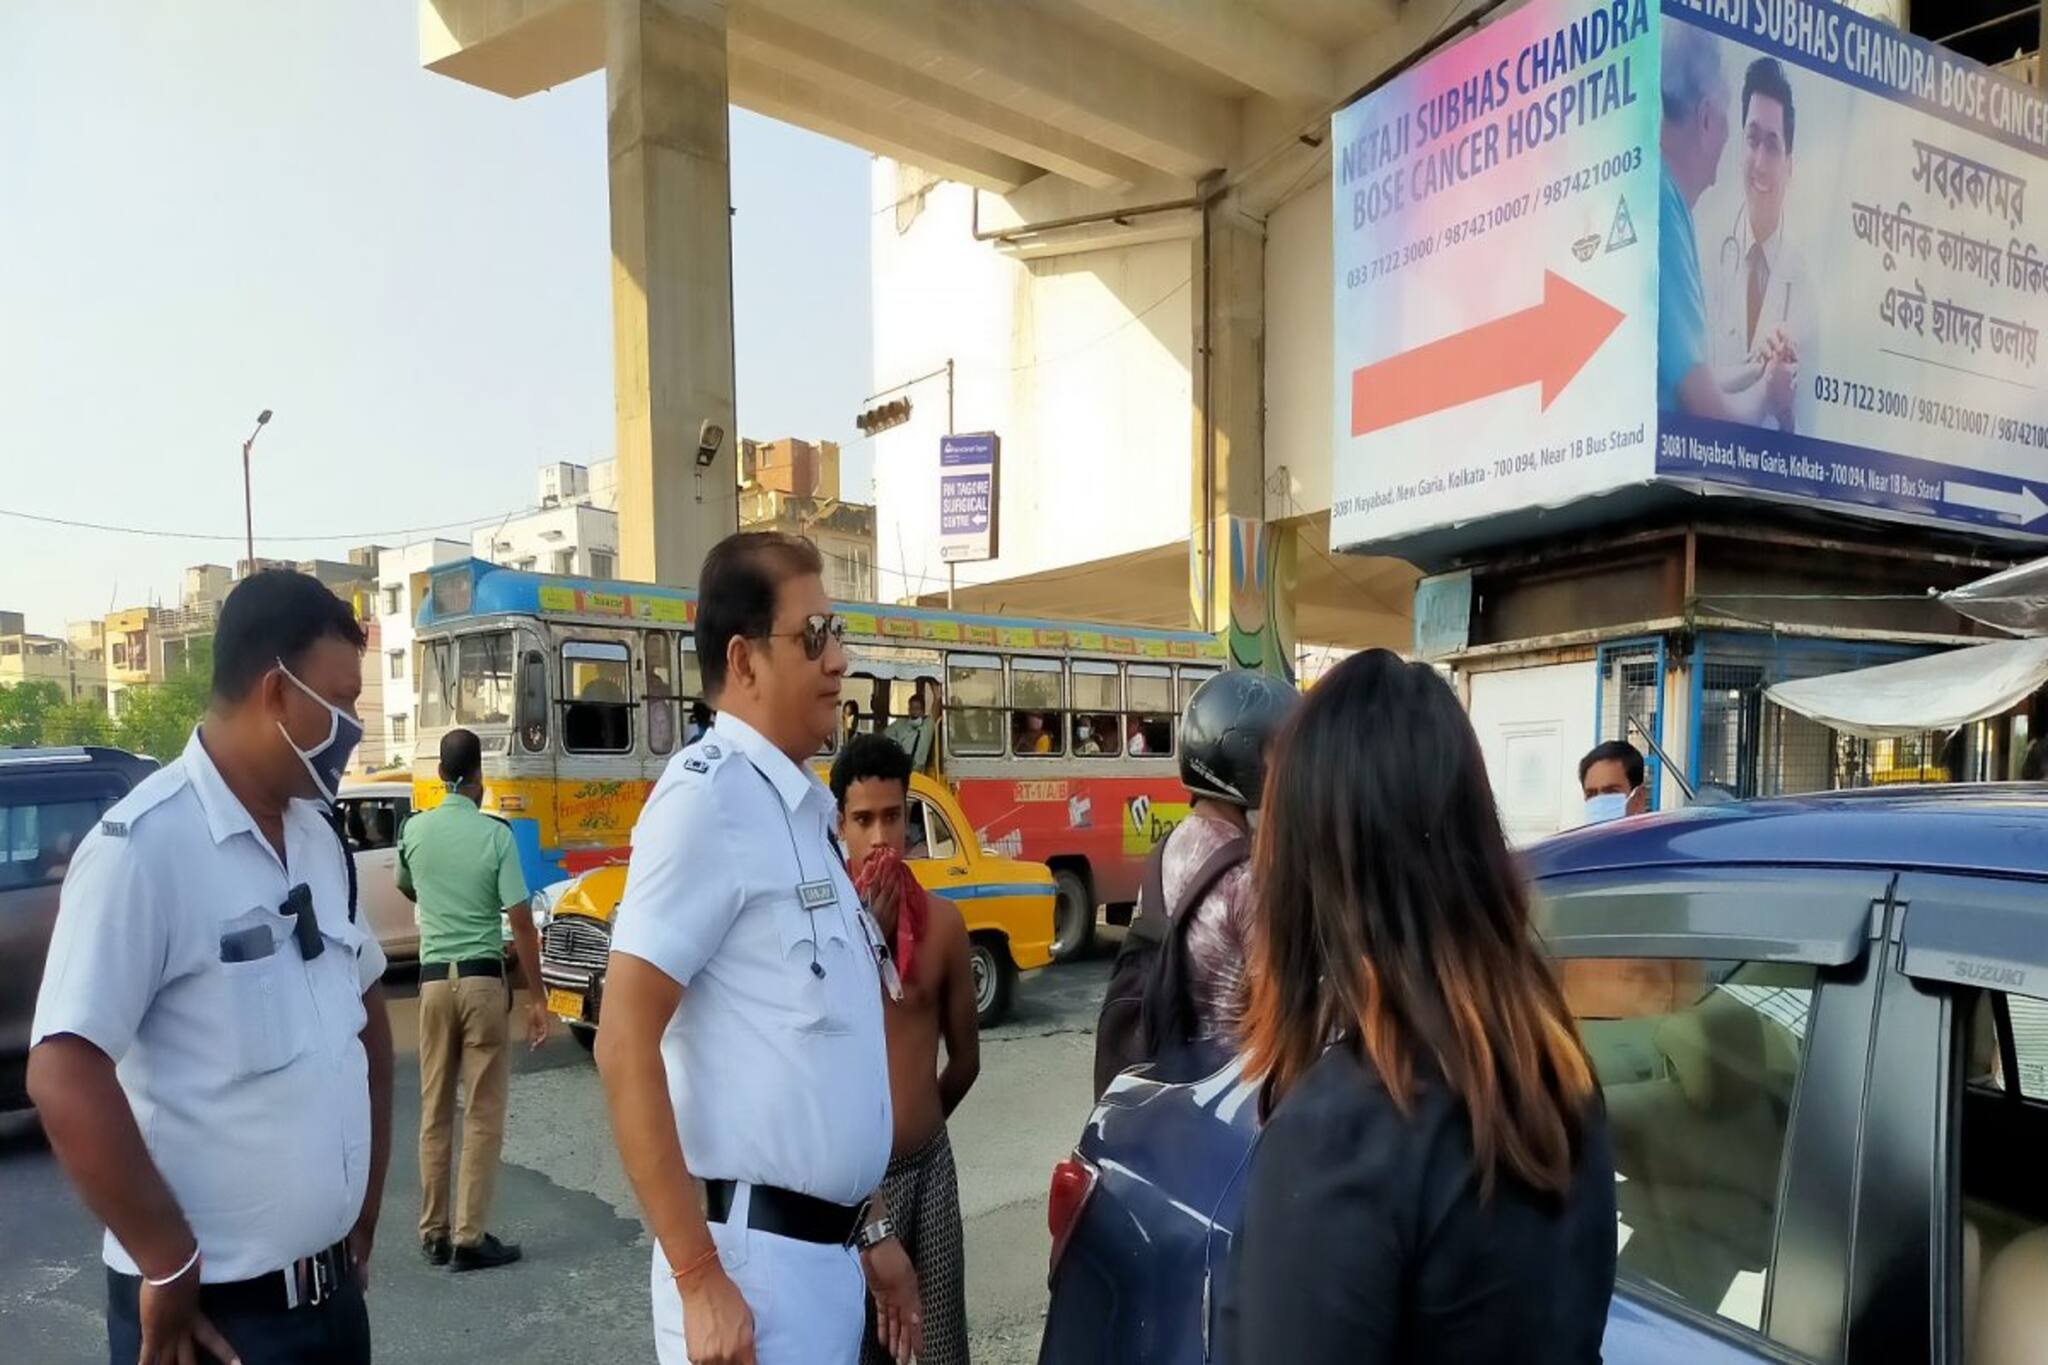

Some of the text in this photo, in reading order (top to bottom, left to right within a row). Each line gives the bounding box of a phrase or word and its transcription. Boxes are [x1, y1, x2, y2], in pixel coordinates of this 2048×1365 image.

[1341, 0, 1649, 186] NETAJI SUBHAS CHANDRA
[1754, 0, 1839, 64] SUBHAS
[1844, 21, 1935, 102] CHANDRA
[1941, 59, 1987, 121] BOSE
[1353, 56, 1638, 232] BOSE CANCER HOSPITAL
[1346, 146, 1643, 290] 033 7122 3000 / 9874210007 / 9874210003
[1912, 138, 2028, 230] সবরকমের
[1851, 201, 1934, 272] আধুনিক
[1880, 277, 1928, 338] একই
[1932, 299, 1985, 354] ছাদের
[1815, 374, 1840, 404] 033
[1843, 381, 1875, 411] 7122
[1877, 388, 1908, 418] 3000
[1909, 395, 1918, 422] /
[1919, 398, 1990, 438] 9874210007
[1448, 466, 1486, 491] Kolkata
[1492, 458, 1513, 479] 700
[1514, 451, 1538, 475] 094,
[1540, 445, 1566, 467] Near
[1569, 439, 1583, 460] 1B
[1585, 434, 1607, 455] Bus
[1608, 422, 1645, 451] Stand
[1737, 445, 1760, 470] New
[1760, 449, 1789, 478] Garia,
[1789, 455, 1825, 483] Kolkata
[1830, 462, 1847, 485] 700
[1867, 469, 1890, 492] Near
[1900, 474, 1917, 497] Bus
[1916, 478, 1942, 501] Stand
[943, 495, 988, 513] SURGICAL
[1953, 960, 2027, 987] SUZUKI
